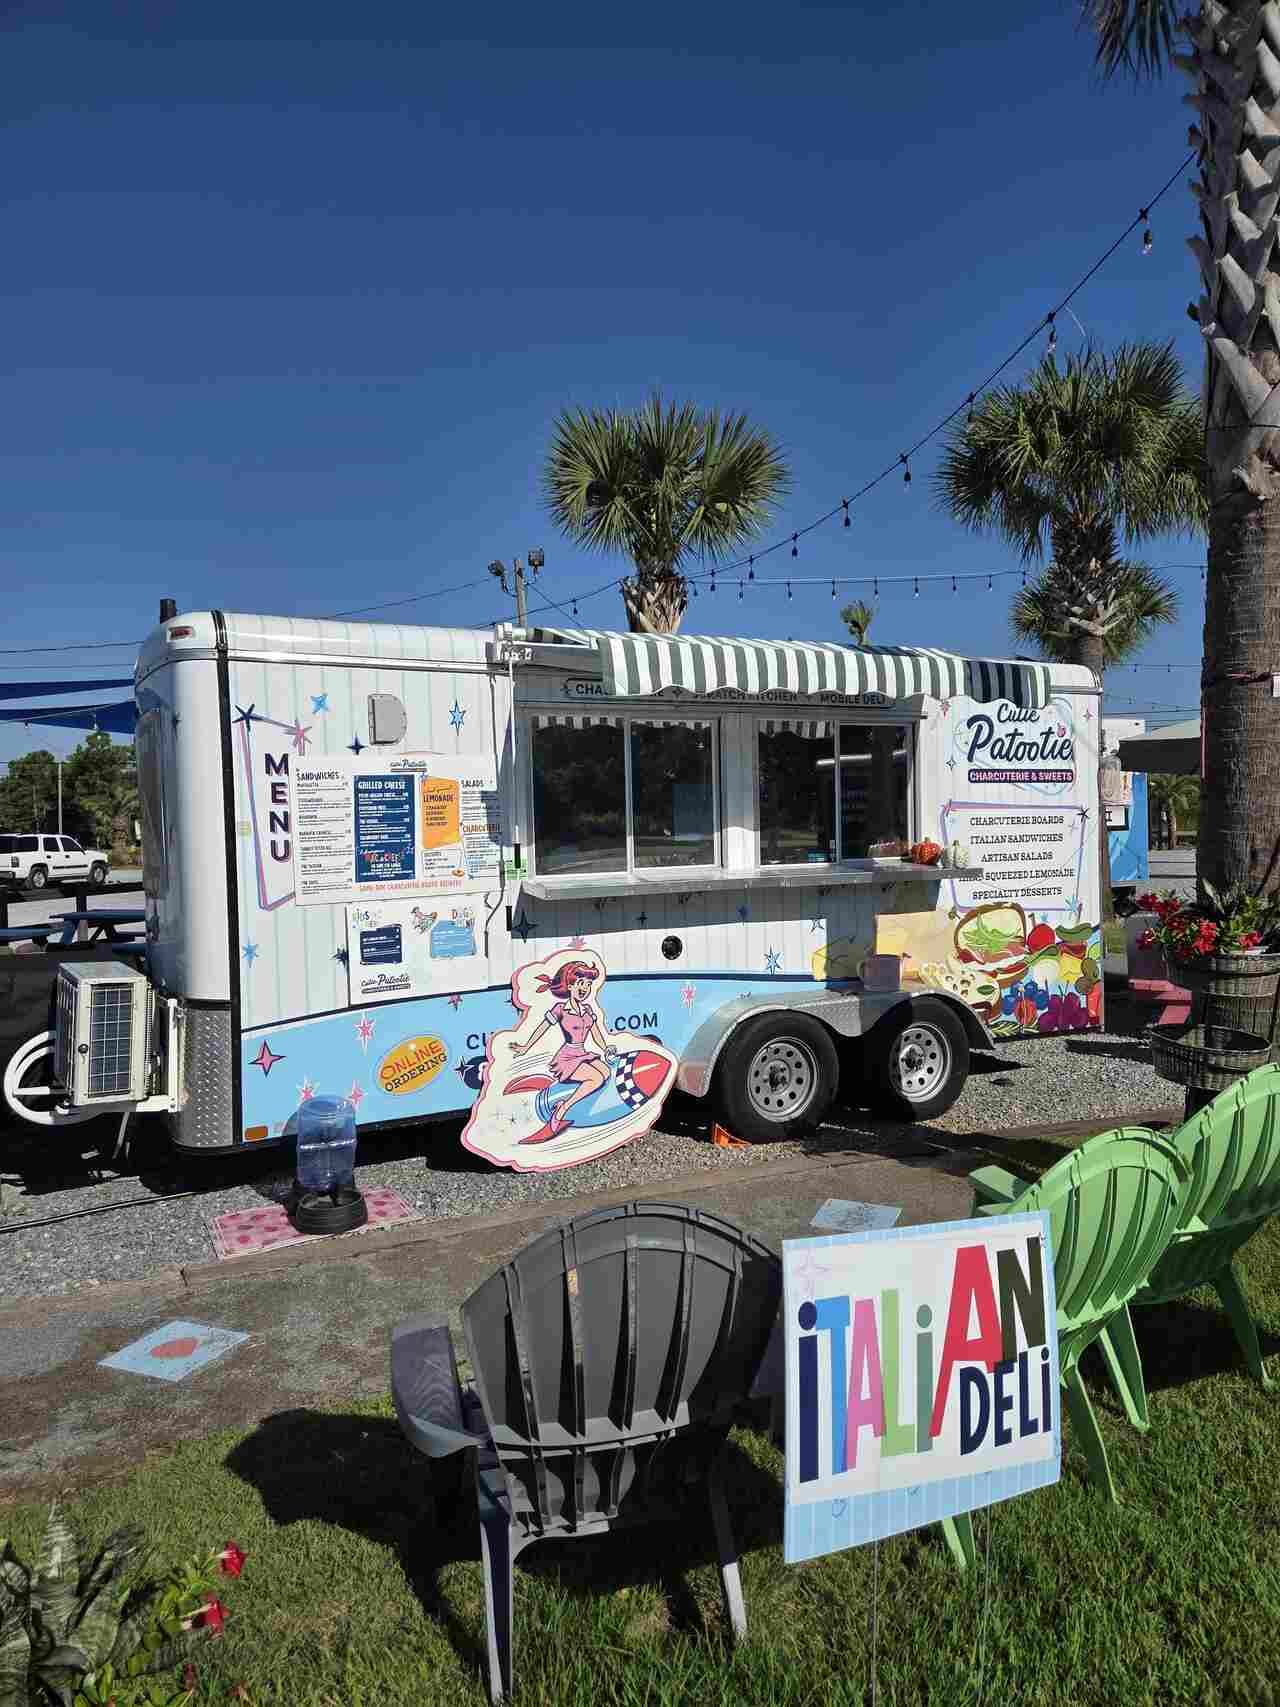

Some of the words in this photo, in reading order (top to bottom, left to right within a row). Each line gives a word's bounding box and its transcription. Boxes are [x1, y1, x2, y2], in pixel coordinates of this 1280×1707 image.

[819, 693, 861, 704] MOBILE
[863, 693, 886, 704] DELI
[998, 703, 1041, 723] Cutie
[966, 713, 1074, 763] Patootie
[296, 771, 340, 781] SANDWICHES
[970, 771, 1030, 782] CHARCUTERIE
[1031, 771, 1038, 781] &
[1039, 771, 1073, 782] SWEETS
[423, 793, 454, 803] LEMONADE
[264, 752, 290, 862] MENU
[970, 816, 1030, 826] CHARCUTERIE
[1031, 815, 1064, 825] BOARDS
[970, 835, 1006, 845] ITALIAN
[1007, 833, 1063, 844] SANDWICHES
[981, 853, 1020, 863] ARTISAN
[1021, 852, 1053, 862] SALADS
[985, 870, 1029, 881] SQUEEZED
[1029, 868, 1076, 879] LEMONADE
[972, 889, 1021, 900] SPECIALTY
[1021, 887, 1063, 897] DESSERTS
[379, 1040, 442, 1079] ONLINE
[384, 1053, 449, 1092] ORDERING
